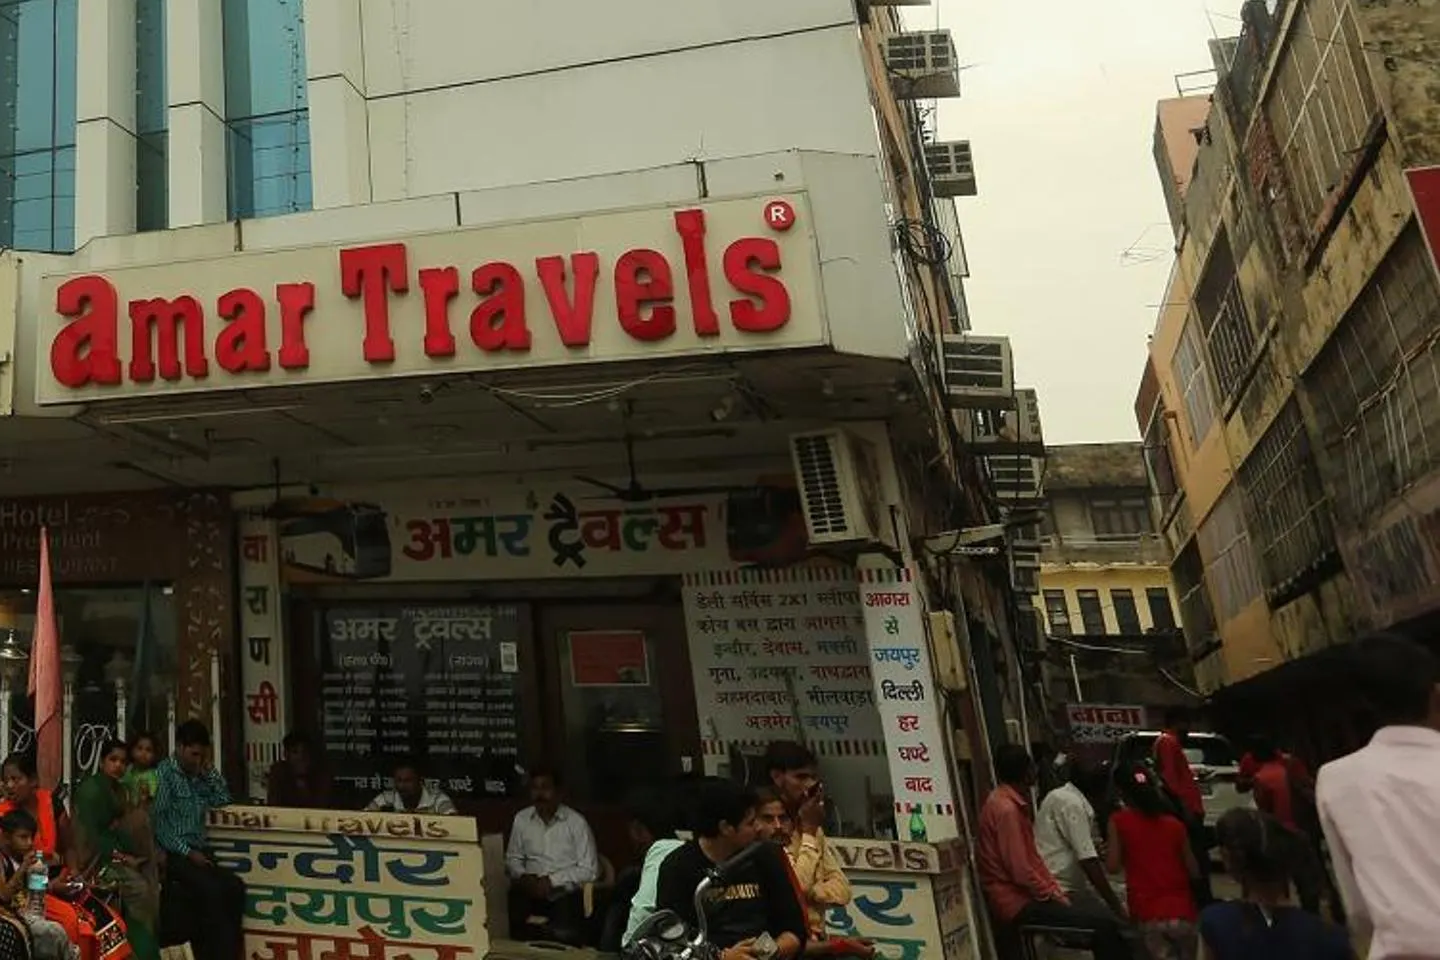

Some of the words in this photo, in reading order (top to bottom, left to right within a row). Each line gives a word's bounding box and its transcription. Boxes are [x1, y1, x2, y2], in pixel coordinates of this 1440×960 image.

[50, 274, 315, 390] amar
[338, 208, 793, 366] Travels
[0, 499, 69, 528] Hotel
[402, 512, 535, 561] अमर
[4, 556, 118, 577] RESURANT
[865, 592, 911, 607] आगरा
[331, 617, 400, 641] अमर
[884, 615, 899, 634] से
[872, 648, 920, 670] जयपुर
[881, 680, 925, 702] दिल्ली
[896, 715, 920, 732] हर
[904, 777, 934, 792] बाद
[210, 809, 276, 829] mar
[244, 885, 473, 939] दयपुर
